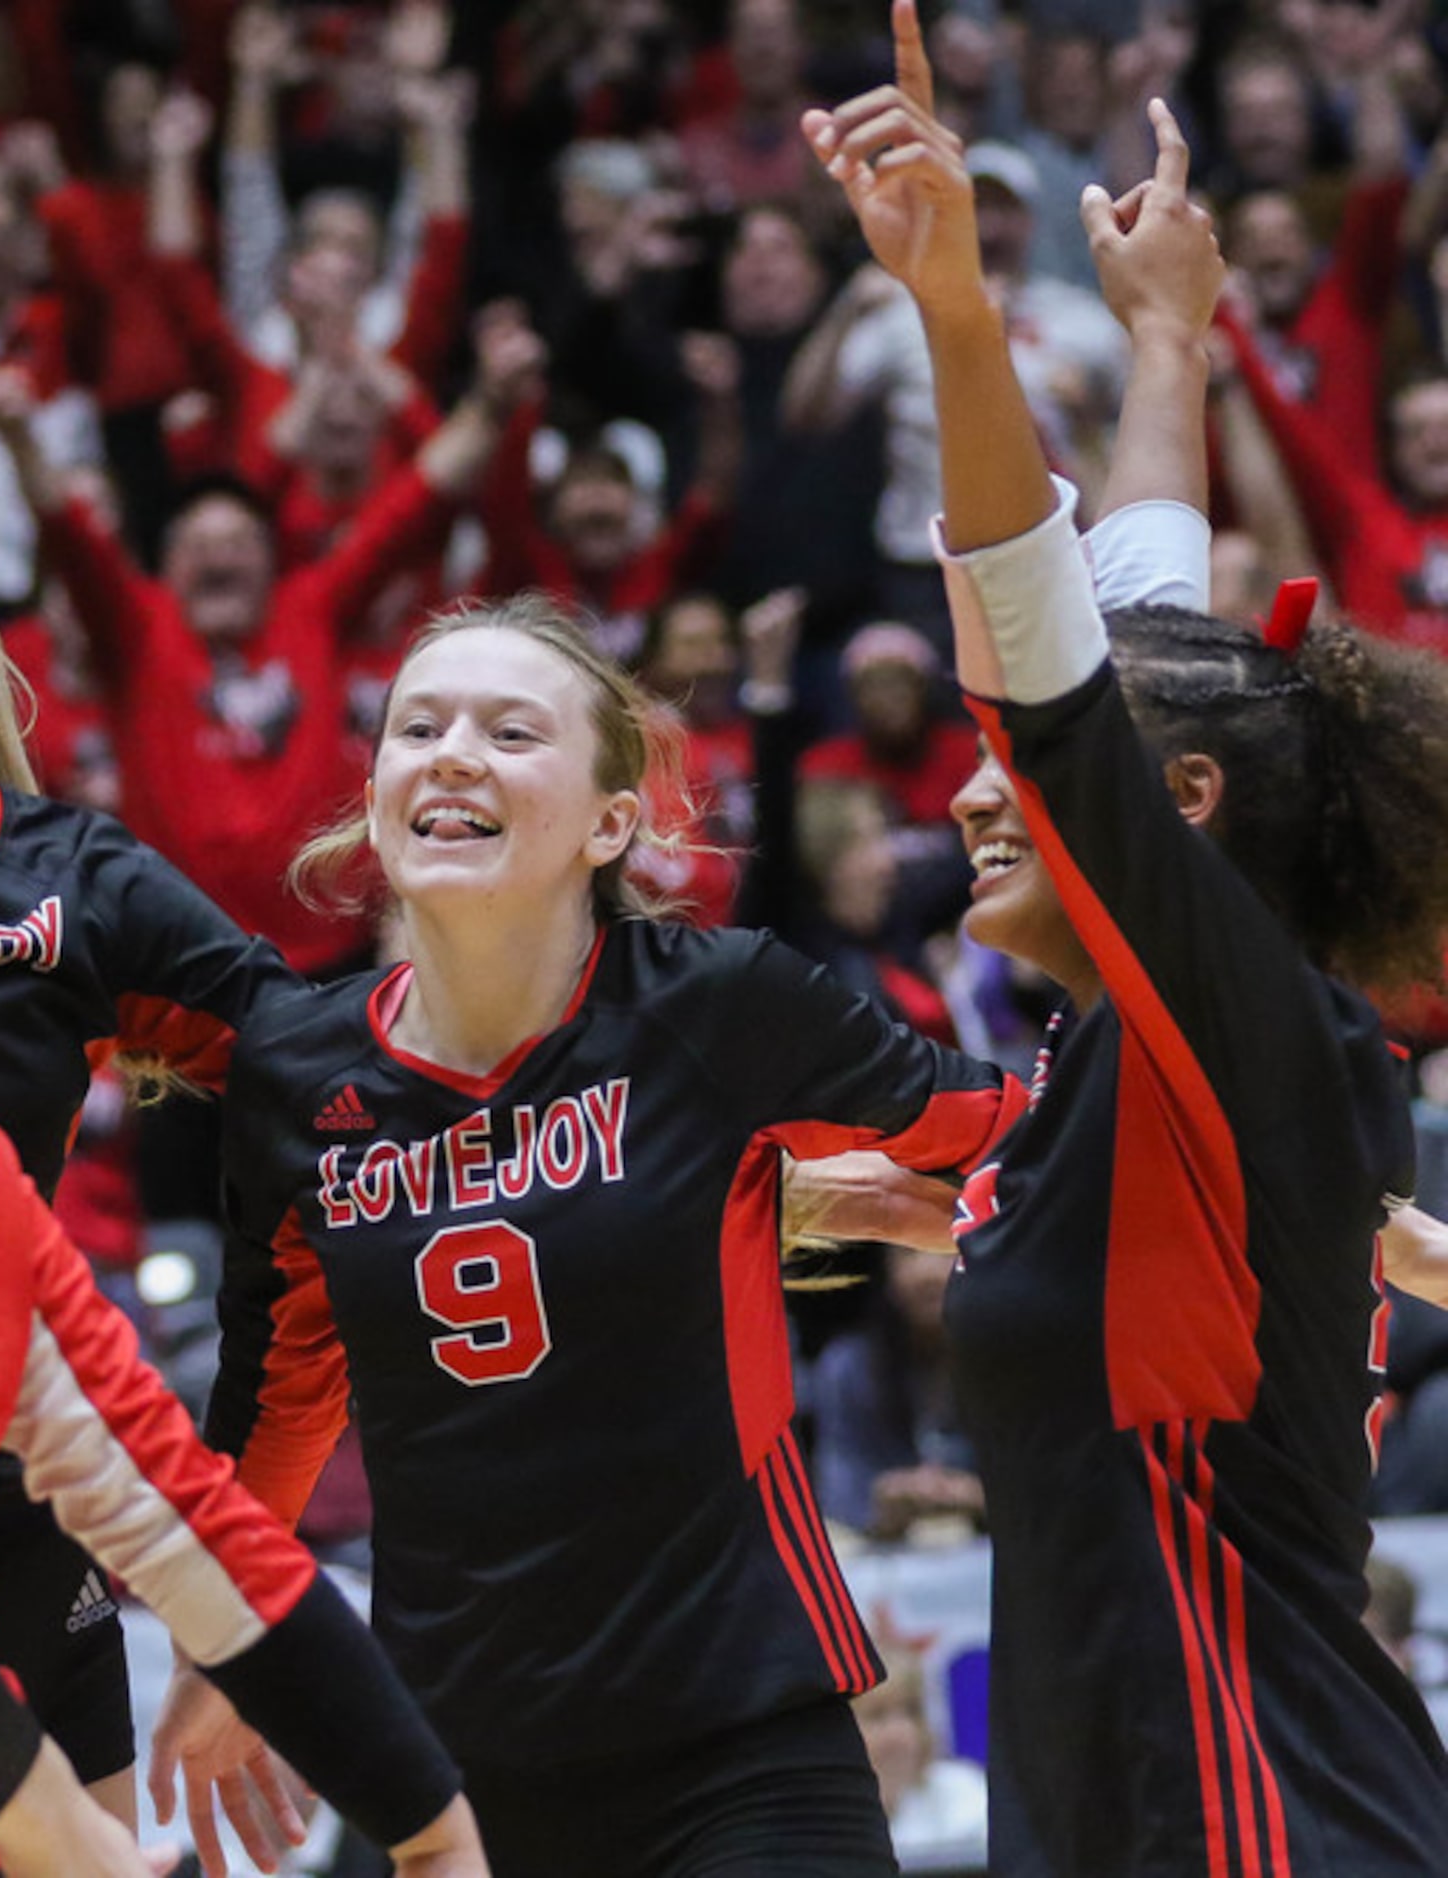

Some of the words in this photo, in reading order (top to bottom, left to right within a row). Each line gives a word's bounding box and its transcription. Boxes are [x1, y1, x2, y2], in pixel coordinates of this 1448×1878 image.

[316, 1077, 630, 1229] LOVEJOY
[415, 1219, 552, 1387] 9
[65, 1598, 118, 1634] adidas
